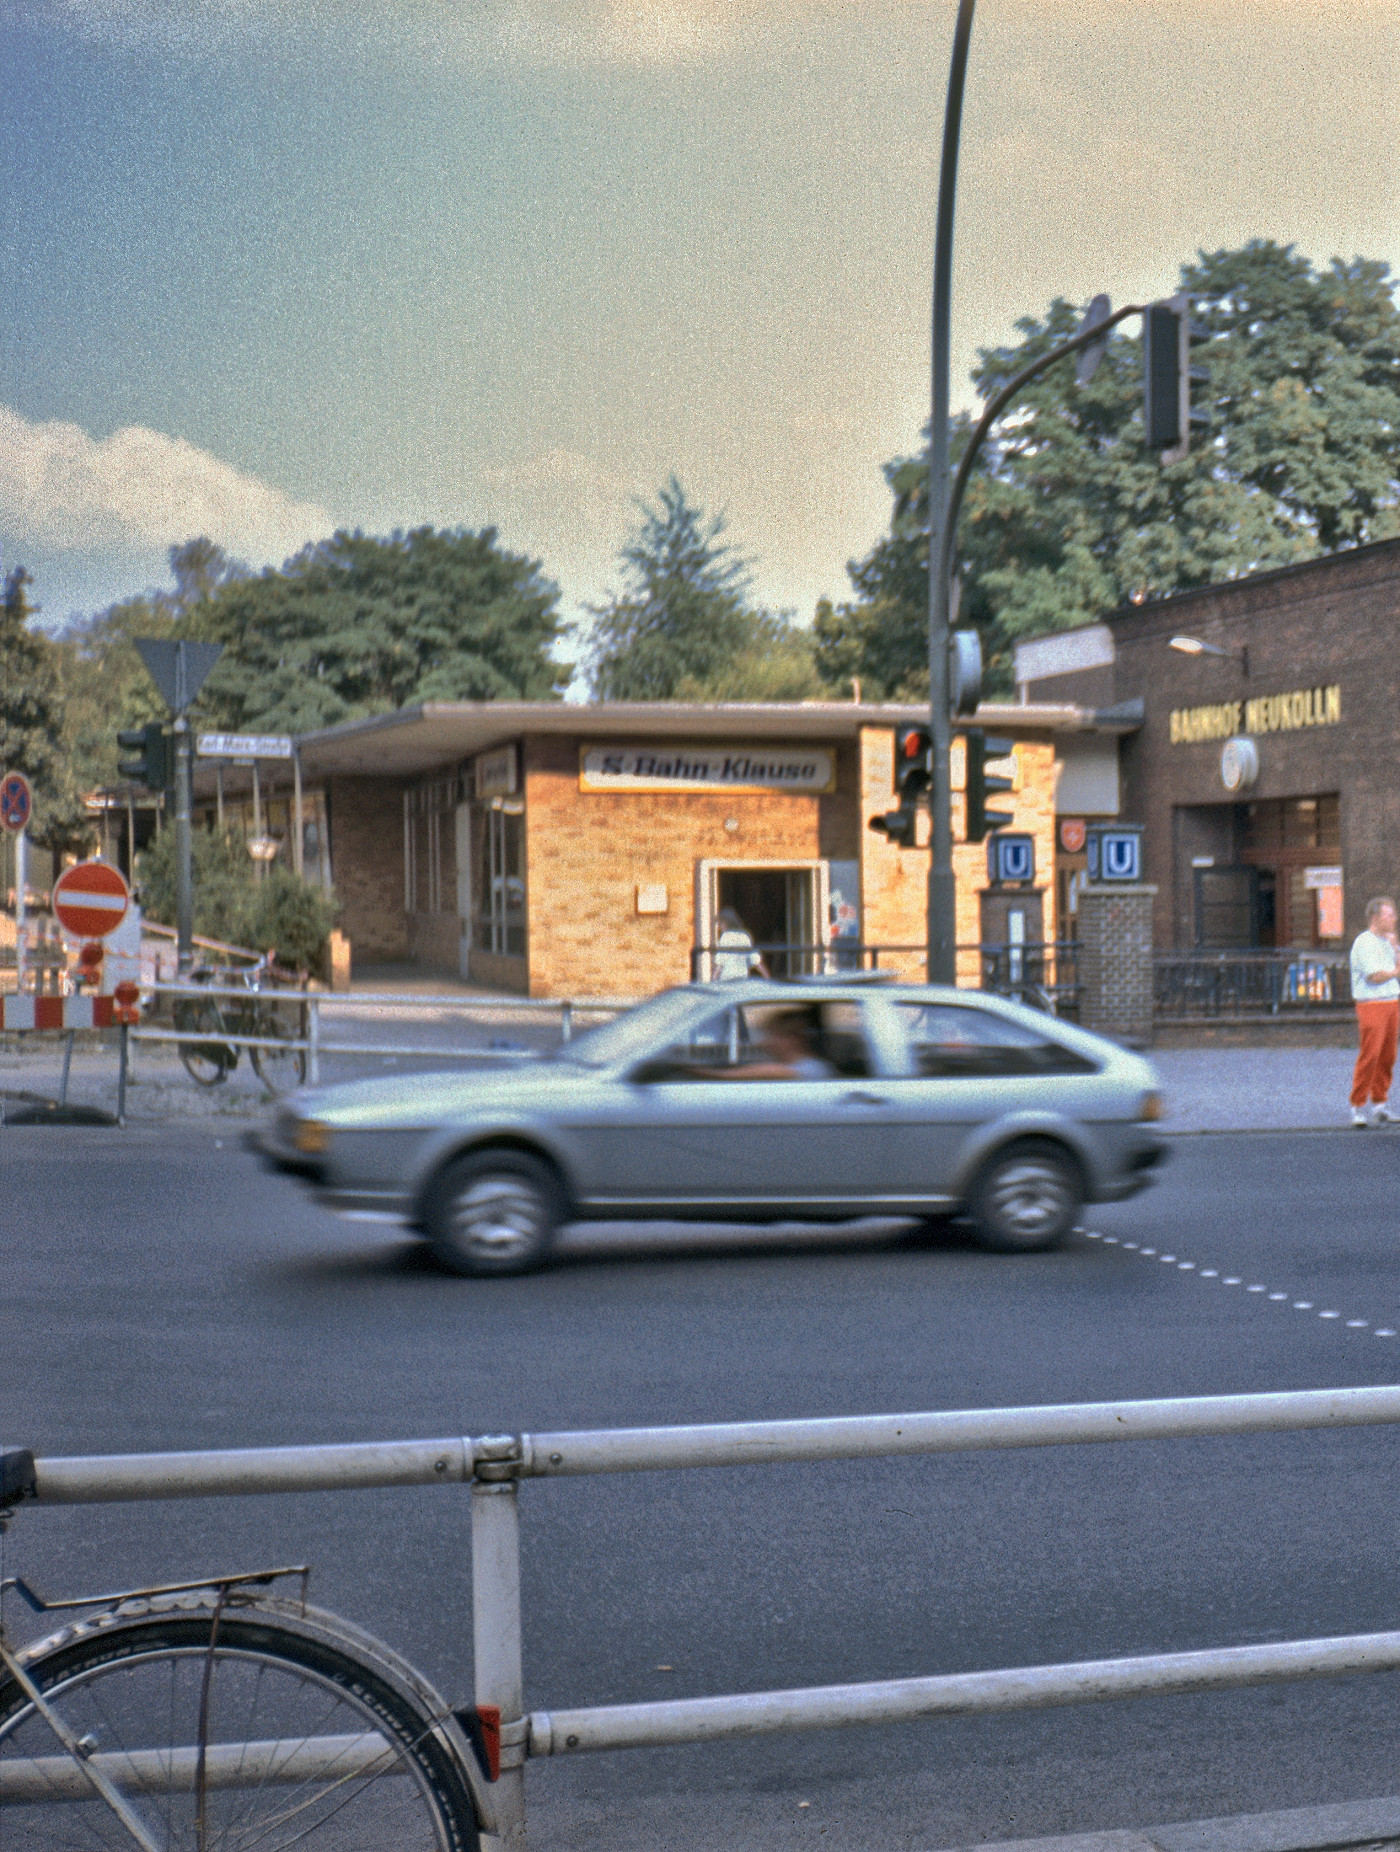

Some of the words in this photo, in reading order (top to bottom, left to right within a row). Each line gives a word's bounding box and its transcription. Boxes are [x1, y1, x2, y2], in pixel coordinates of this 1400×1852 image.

[1170, 701, 1242, 745] BAHNHOF
[1006, 845, 1027, 875] U
[1109, 839, 1132, 874] U
